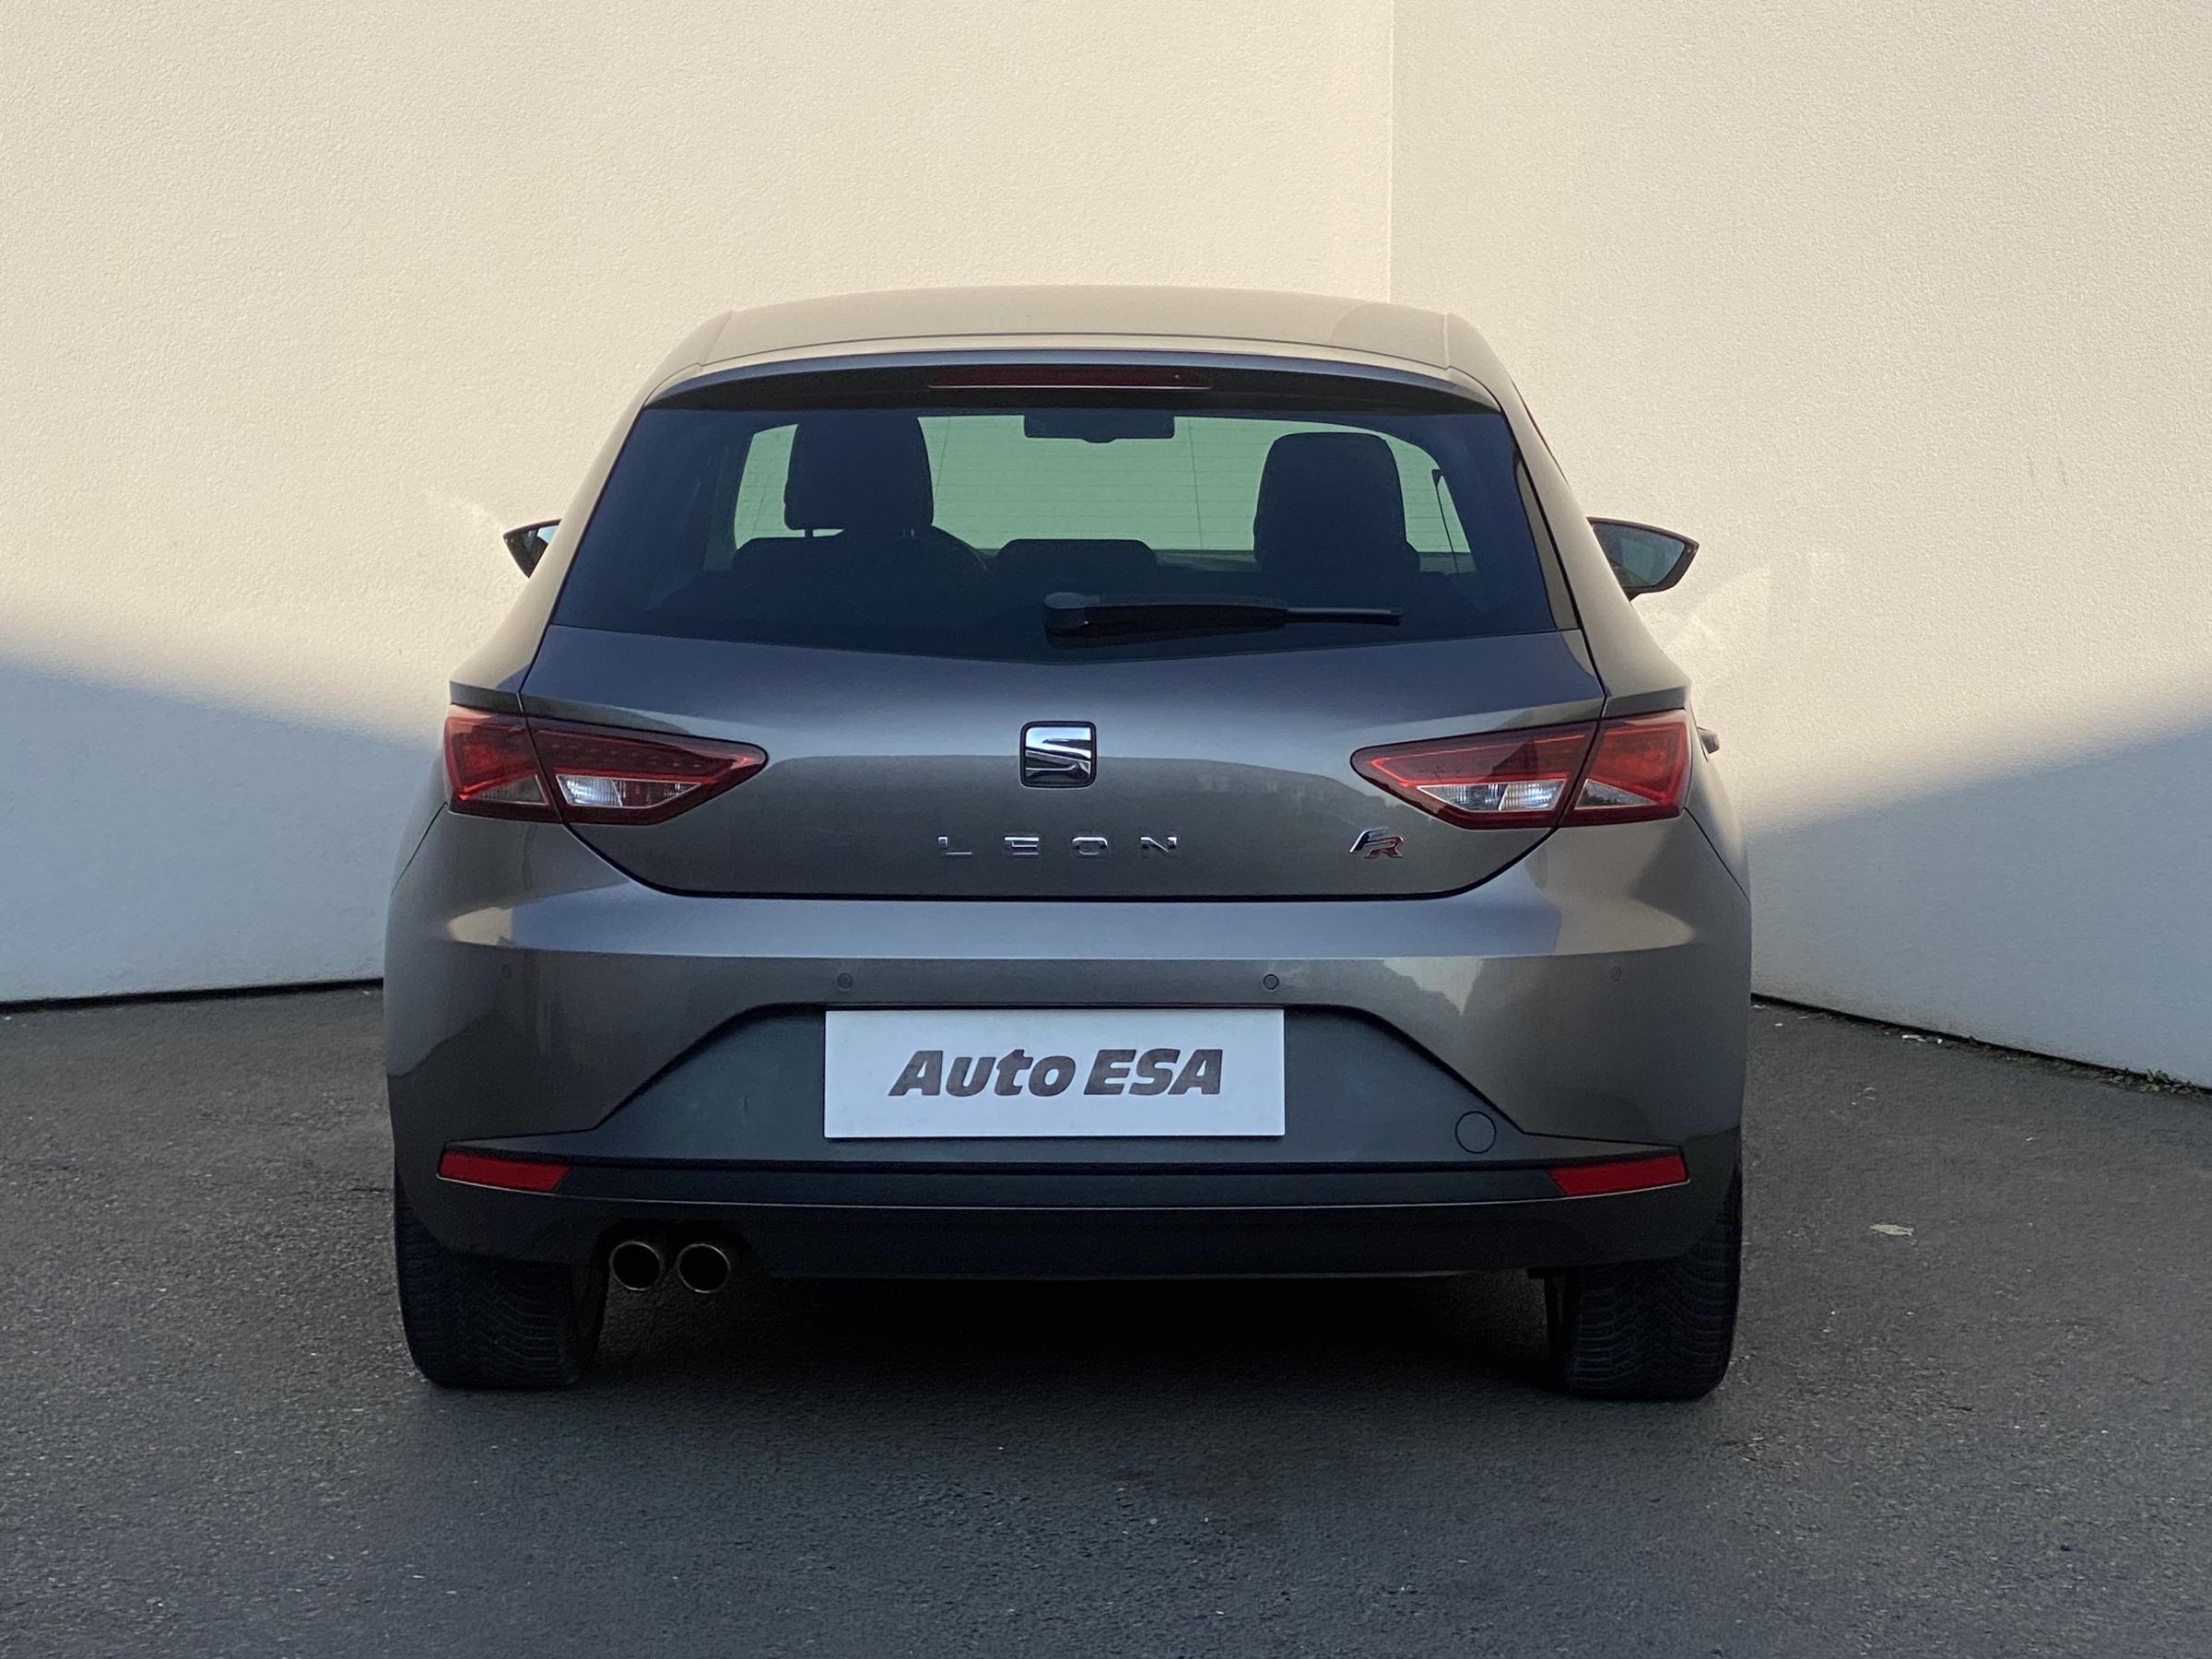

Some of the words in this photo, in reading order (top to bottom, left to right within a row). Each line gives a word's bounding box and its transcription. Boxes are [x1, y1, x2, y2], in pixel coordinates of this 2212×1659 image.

[937, 835, 1178, 856] LEON
[888, 1049, 1077, 1098] Auto
[1084, 1048, 1223, 1096] ESA
